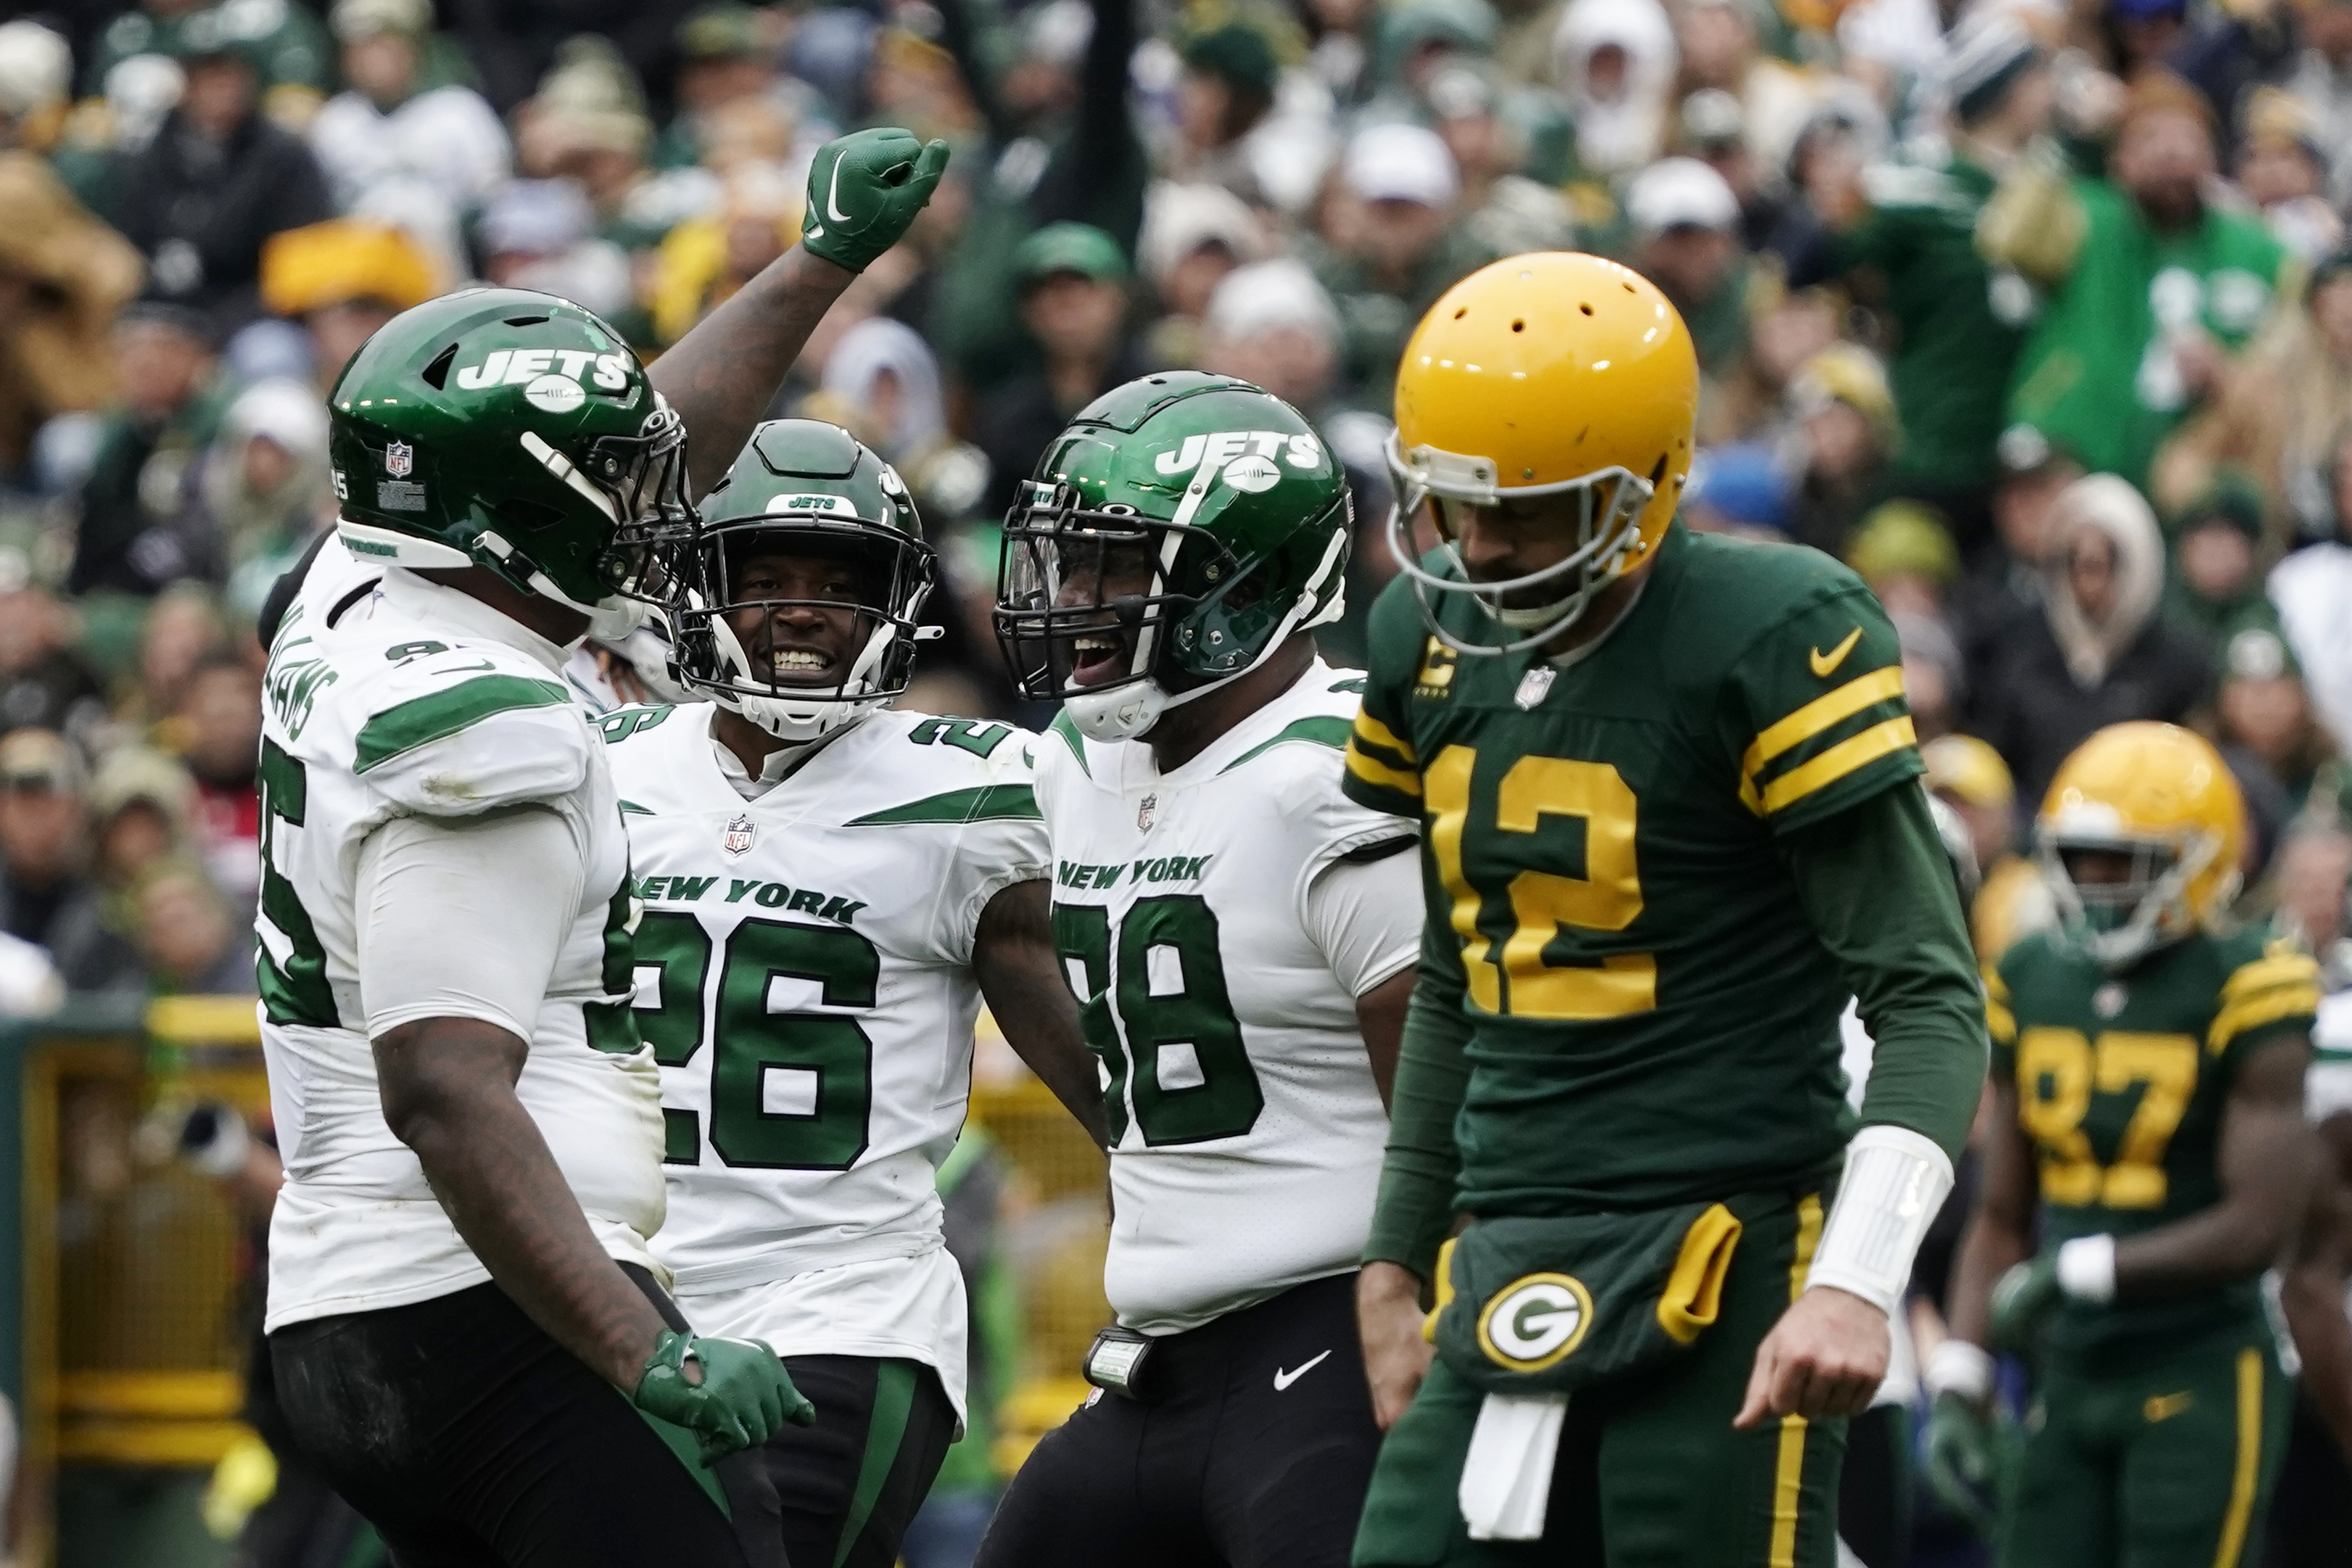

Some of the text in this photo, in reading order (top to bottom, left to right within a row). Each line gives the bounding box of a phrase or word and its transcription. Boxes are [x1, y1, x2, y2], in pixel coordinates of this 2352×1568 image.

[458, 348, 630, 390] JETS
[389, 455, 408, 471] NFL
[1155, 431, 1319, 475] JETS
[331, 469, 349, 500] 5
[788, 497, 836, 510] JETS
[727, 833, 748, 849] NFL
[256, 734, 342, 1028] 5
[1057, 854, 1213, 890] NEW YORK
[1424, 744, 1656, 1020] 12
[637, 875, 868, 925] EW YORK
[2015, 1026, 2200, 1210] 87
[1487, 1281, 1582, 1361] G
